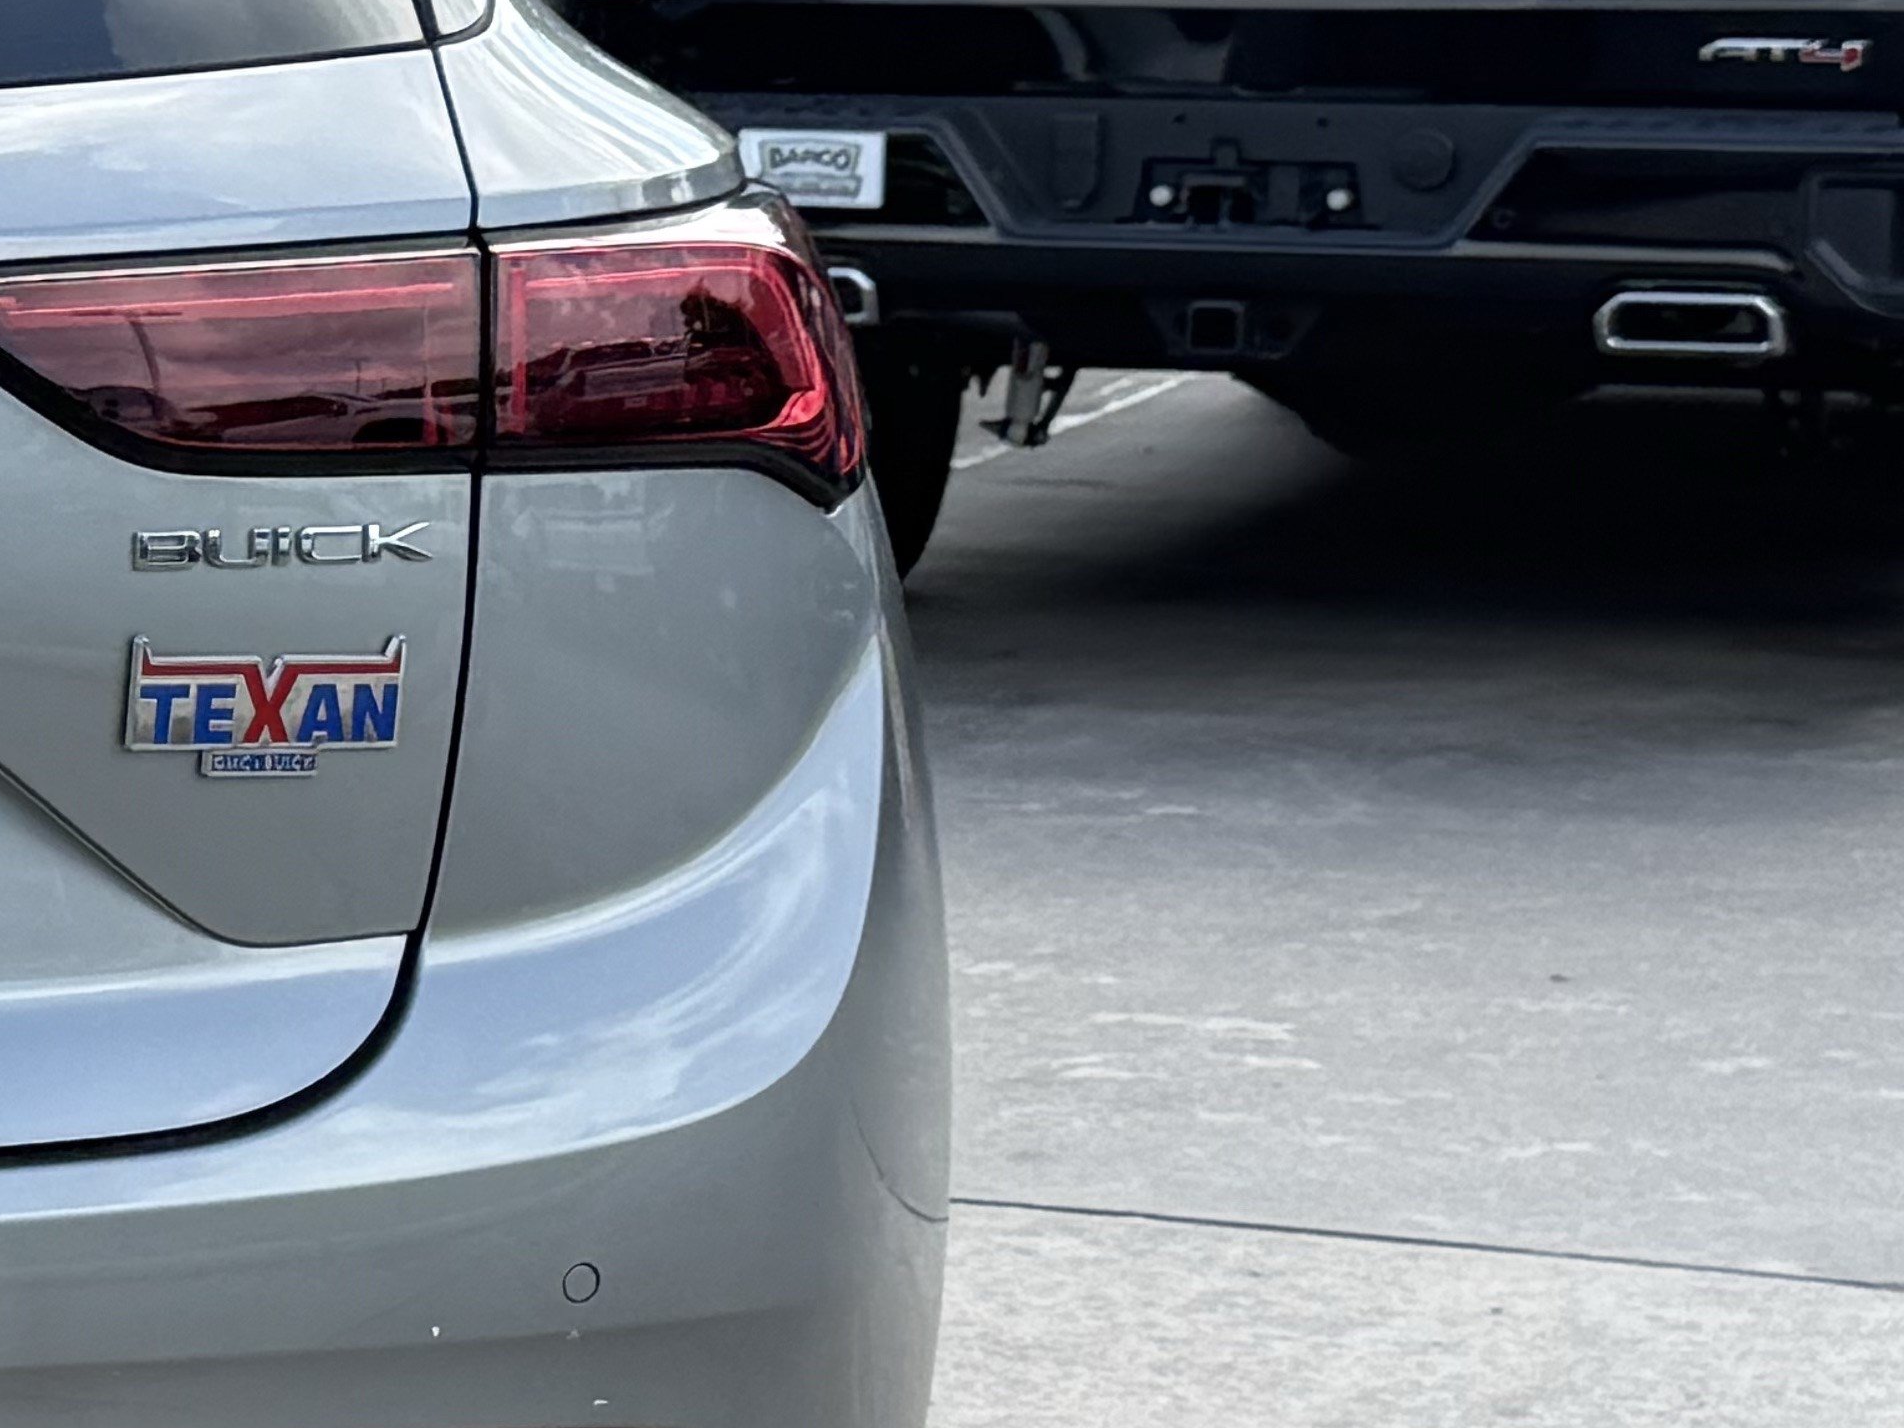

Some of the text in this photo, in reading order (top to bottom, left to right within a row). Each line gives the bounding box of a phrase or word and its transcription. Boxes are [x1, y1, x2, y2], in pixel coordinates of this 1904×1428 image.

[1698, 37, 1873, 72] AT4
[132, 522, 434, 571] BUICK
[138, 662, 400, 746] TEXAN
